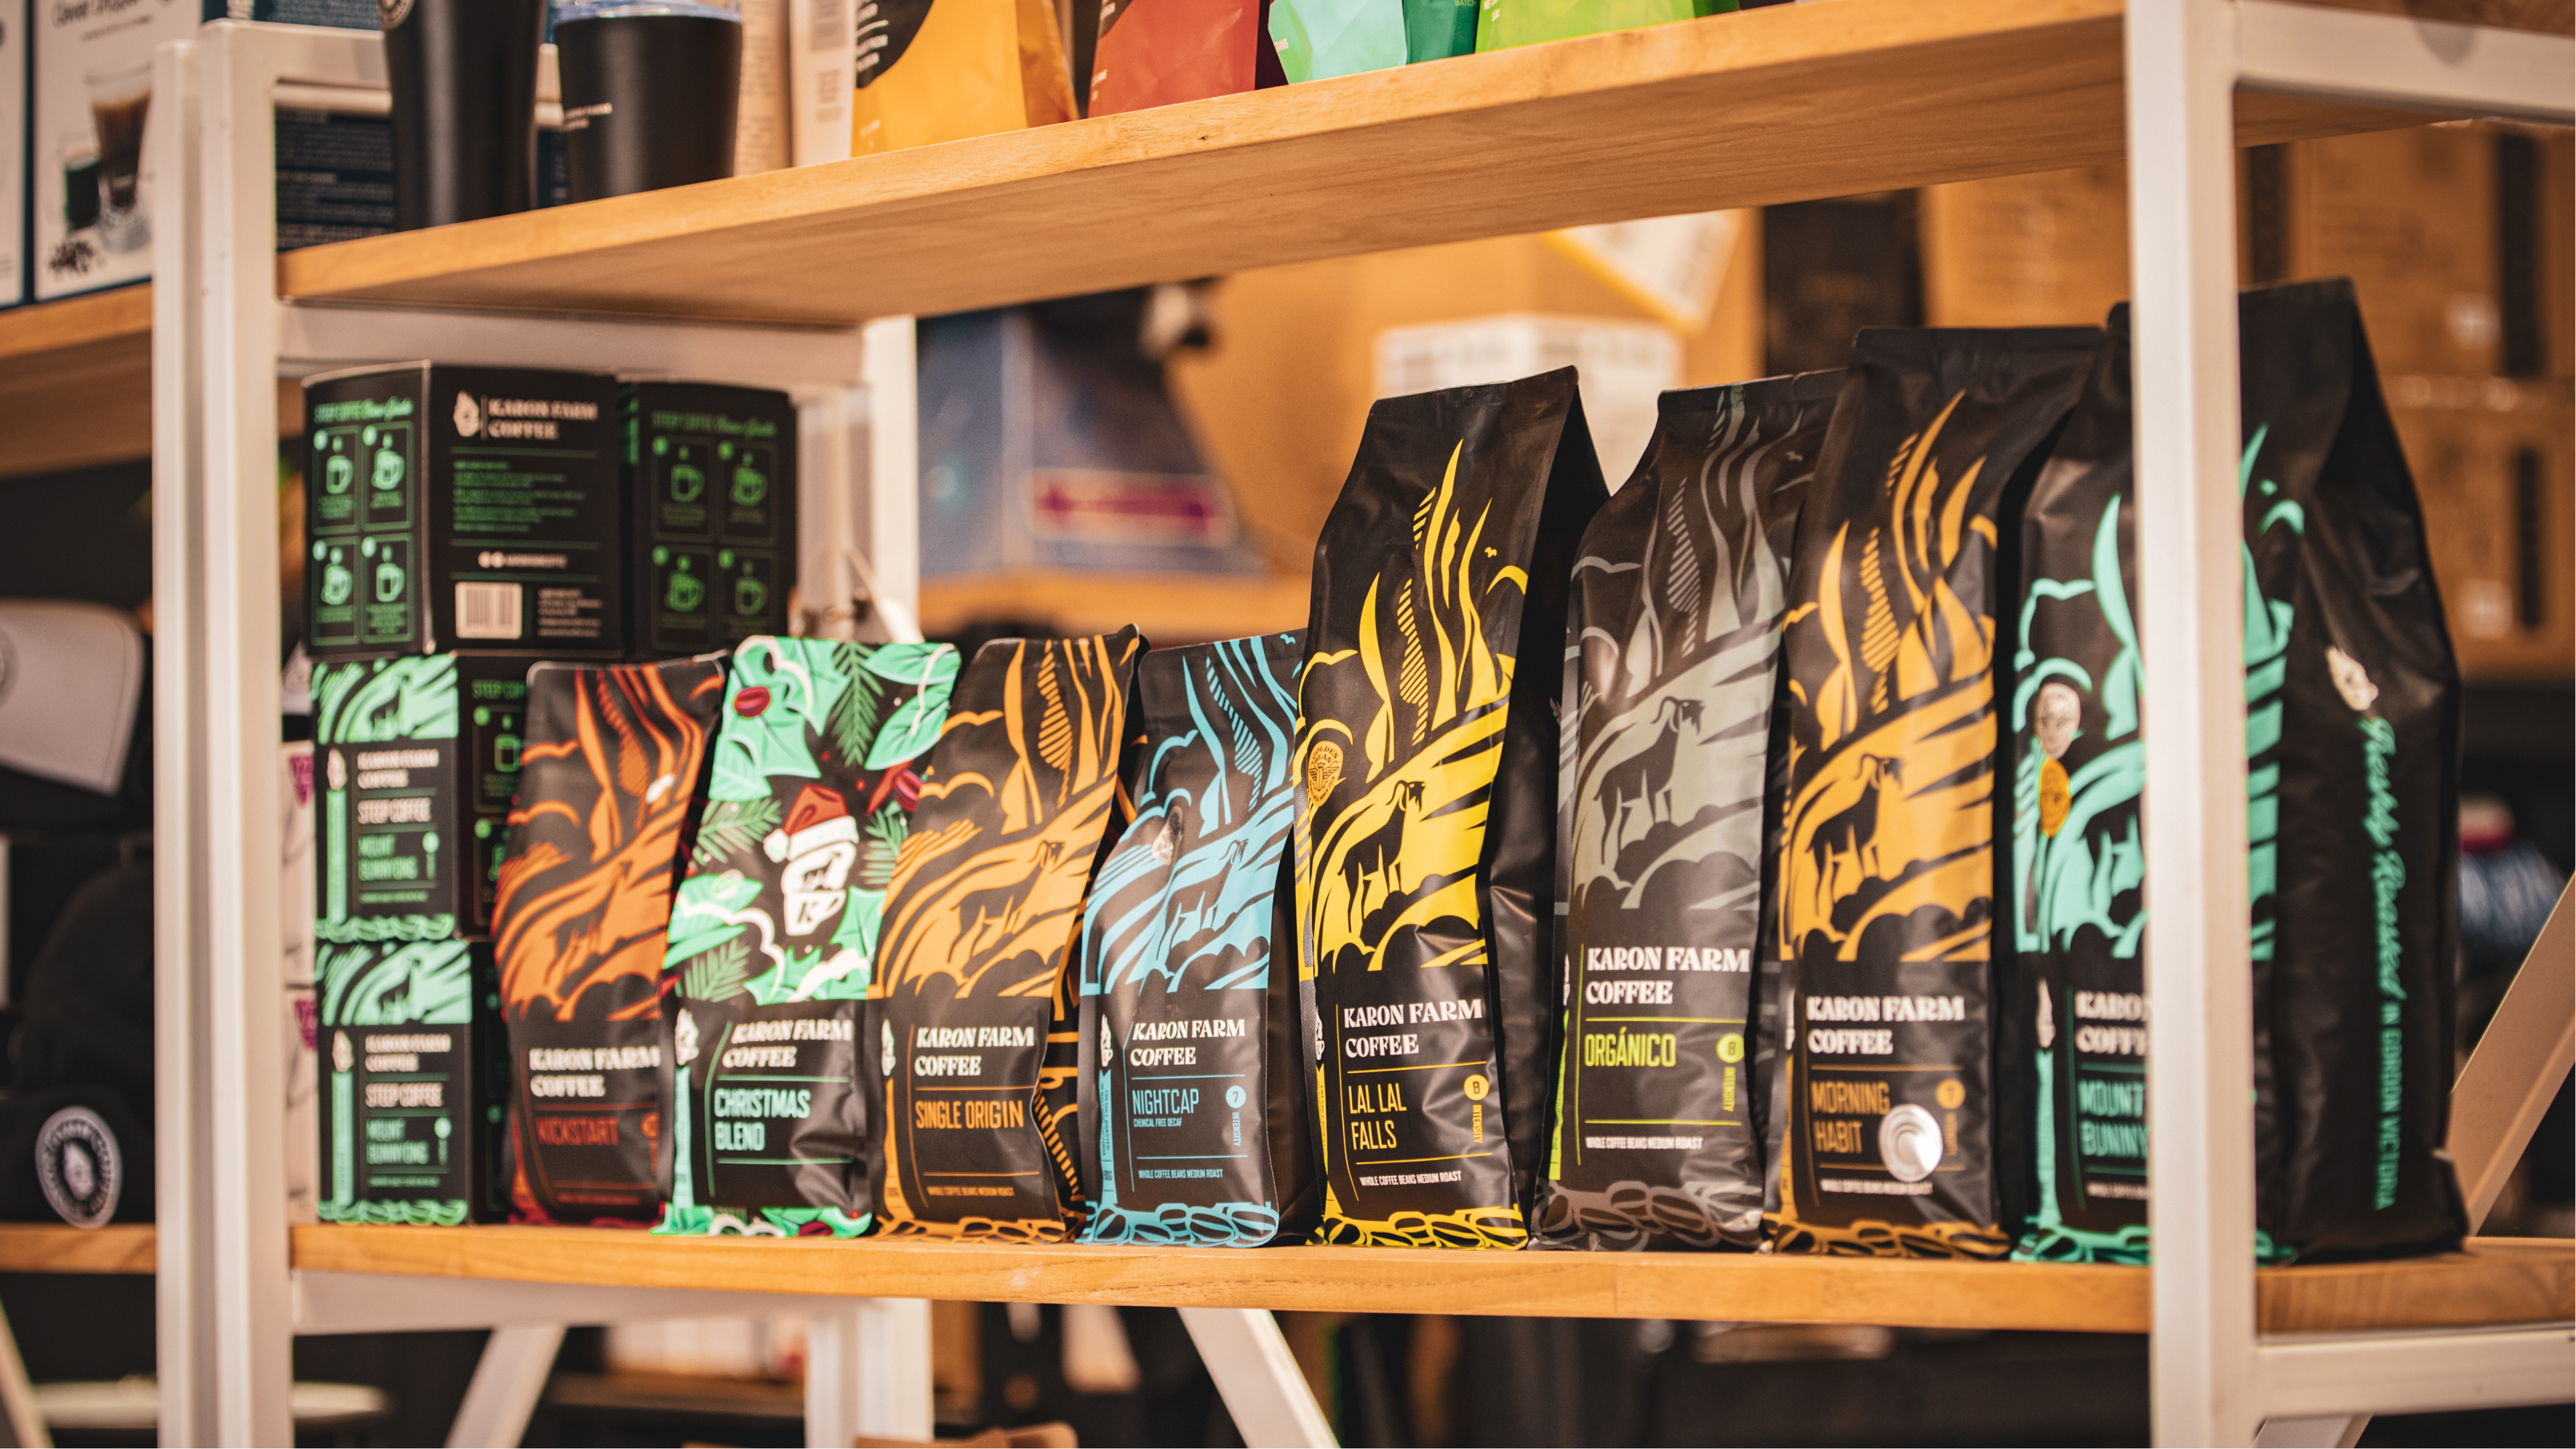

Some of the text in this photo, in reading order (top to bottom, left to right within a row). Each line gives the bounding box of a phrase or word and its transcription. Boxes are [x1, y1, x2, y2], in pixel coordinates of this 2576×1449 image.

[488, 398, 598, 421] KARON FARM
[488, 419, 559, 440] COFFEE
[1313, 745, 1338, 759] GOLDEN
[1315, 753, 1333, 763] BEAN
[358, 769, 409, 789] COFFEE
[2357, 716, 2400, 847] Freshly
[358, 798, 431, 824] STEEP COFFEE
[2370, 849, 2408, 1000] Roasted
[1587, 947, 1750, 972] KARON FARM
[1585, 980, 1673, 1004] COFFEE
[1344, 998, 1483, 1028] KARON FARM
[1806, 995, 1966, 1022] KARON FARM
[2074, 990, 2149, 1021] KARO
[731, 1019, 853, 1044] KARON FARM
[916, 1026, 1034, 1048] KARON FARM
[1132, 1019, 1246, 1040] KARON FARM
[1808, 1028, 1893, 1055] COFFEE
[529, 1046, 661, 1071] KARON FARM
[722, 1046, 797, 1068] COFFEE
[1130, 1046, 1196, 1067] COFFEE
[1345, 1034, 1419, 1059] COFFEE
[1584, 1026, 1676, 1067] ORGÁNICO
[914, 1055, 981, 1076] COFFEE
[366, 1083, 443, 1107] STEEP COFFEE
[531, 1075, 605, 1097] COFFEE
[1232, 1090, 1239, 1104] 7
[1348, 1084, 1375, 1114] LAL
[1377, 1083, 1407, 1113] LAL
[1722, 1065, 1736, 1112] INTENSITY
[1811, 1080, 1891, 1116] MORNING
[2078, 1079, 2146, 1118] MOUNT
[714, 1087, 812, 1119] CHRISTMAS
[915, 1099, 1024, 1129] SINGLE ORIGIN
[1132, 1088, 1199, 1115] NIGHTCAP
[535, 1116, 619, 1146] KICKSTART
[1133, 1117, 1183, 1127] CHEMICAL FREE DECAF
[1232, 1112, 1241, 1147] INTENSITY
[1350, 1119, 1397, 1150] FALLS
[1472, 1104, 1483, 1143] INTENSITY
[714, 1121, 766, 1151] BLEND
[1585, 1136, 1703, 1150] WHOLE COFFEE BEANS MEDIUM ROAST
[1813, 1120, 1863, 1155] HABIT
[1138, 1169, 1223, 1179] WHOLE COFFEE BEANS MEDIUM ROAST
[1359, 1170, 1462, 1186] WHOLE COFFEE BEANS MEDIUM ROAST
